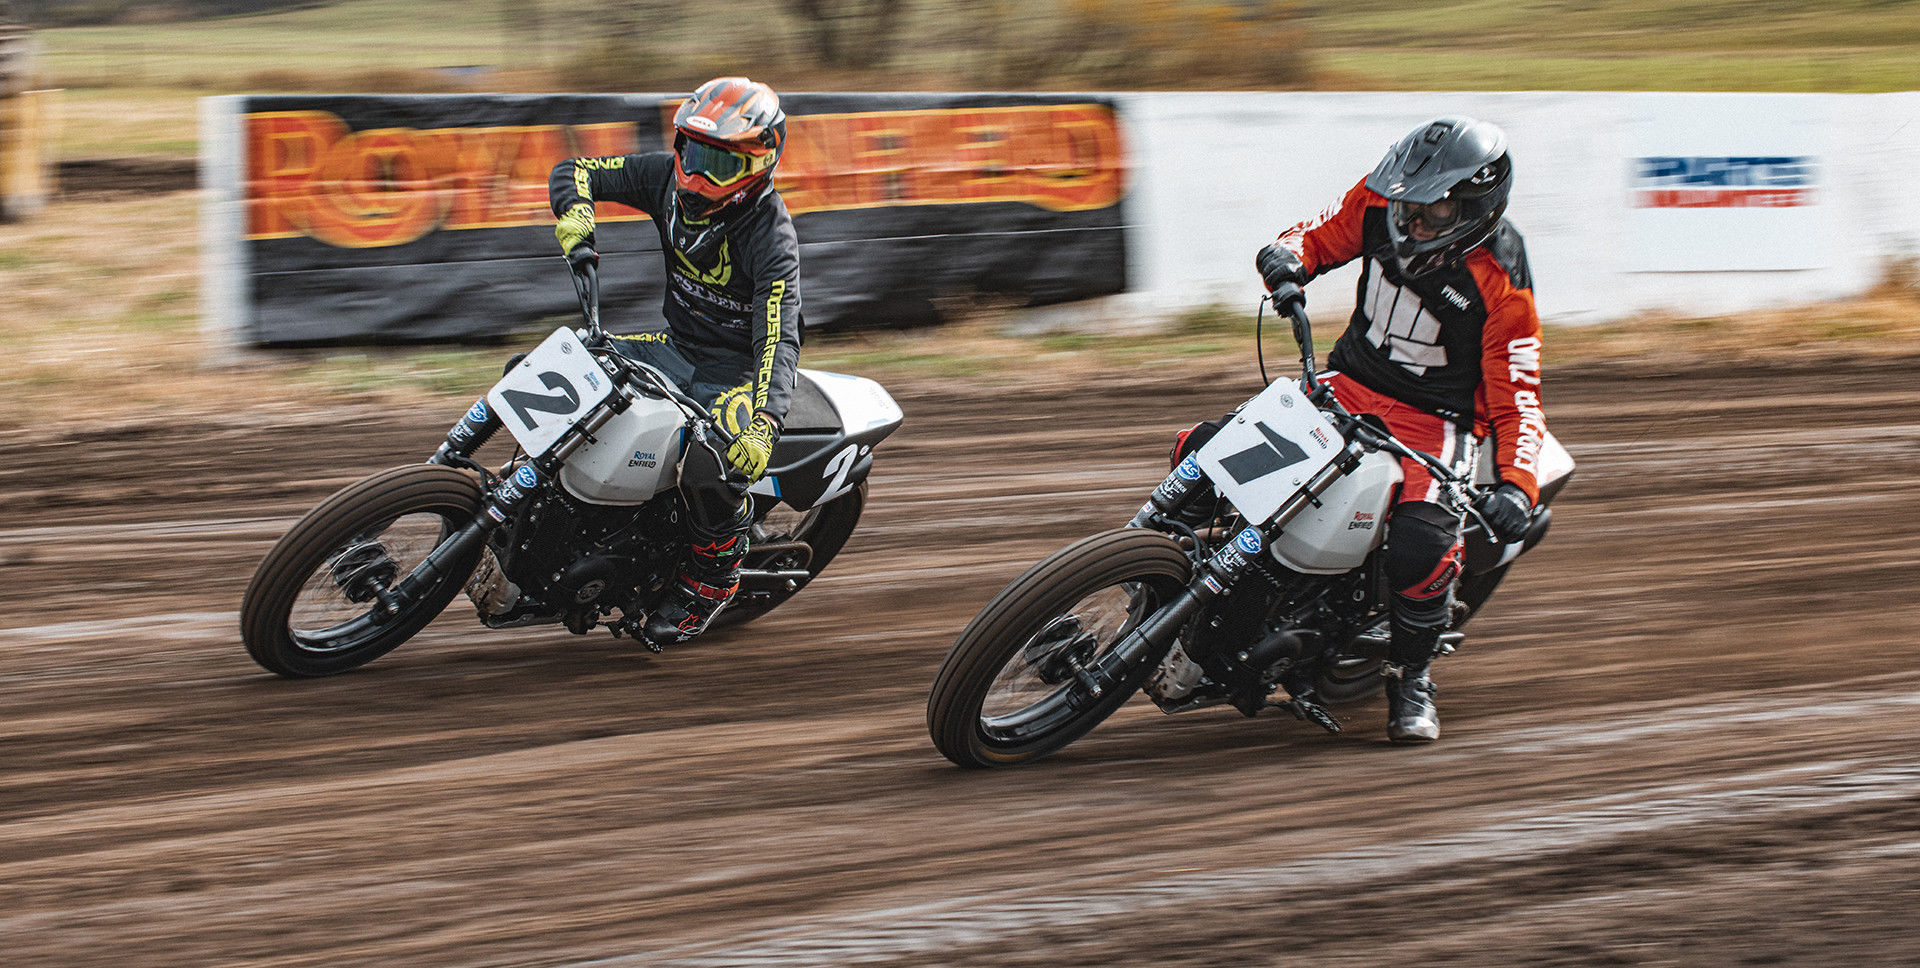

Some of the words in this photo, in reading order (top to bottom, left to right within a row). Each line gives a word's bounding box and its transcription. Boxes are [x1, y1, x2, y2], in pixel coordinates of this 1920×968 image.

[1508, 336, 1542, 385] TWO
[501, 371, 580, 431] 2
[628, 459, 657, 469] ENFIELD
[634, 451, 656, 461] ROYAL
[1218, 421, 1310, 485] 1
[812, 443, 858, 508] 2
[1348, 521, 1375, 531] ENFIELD
[1353, 511, 1375, 521] ROYAL
